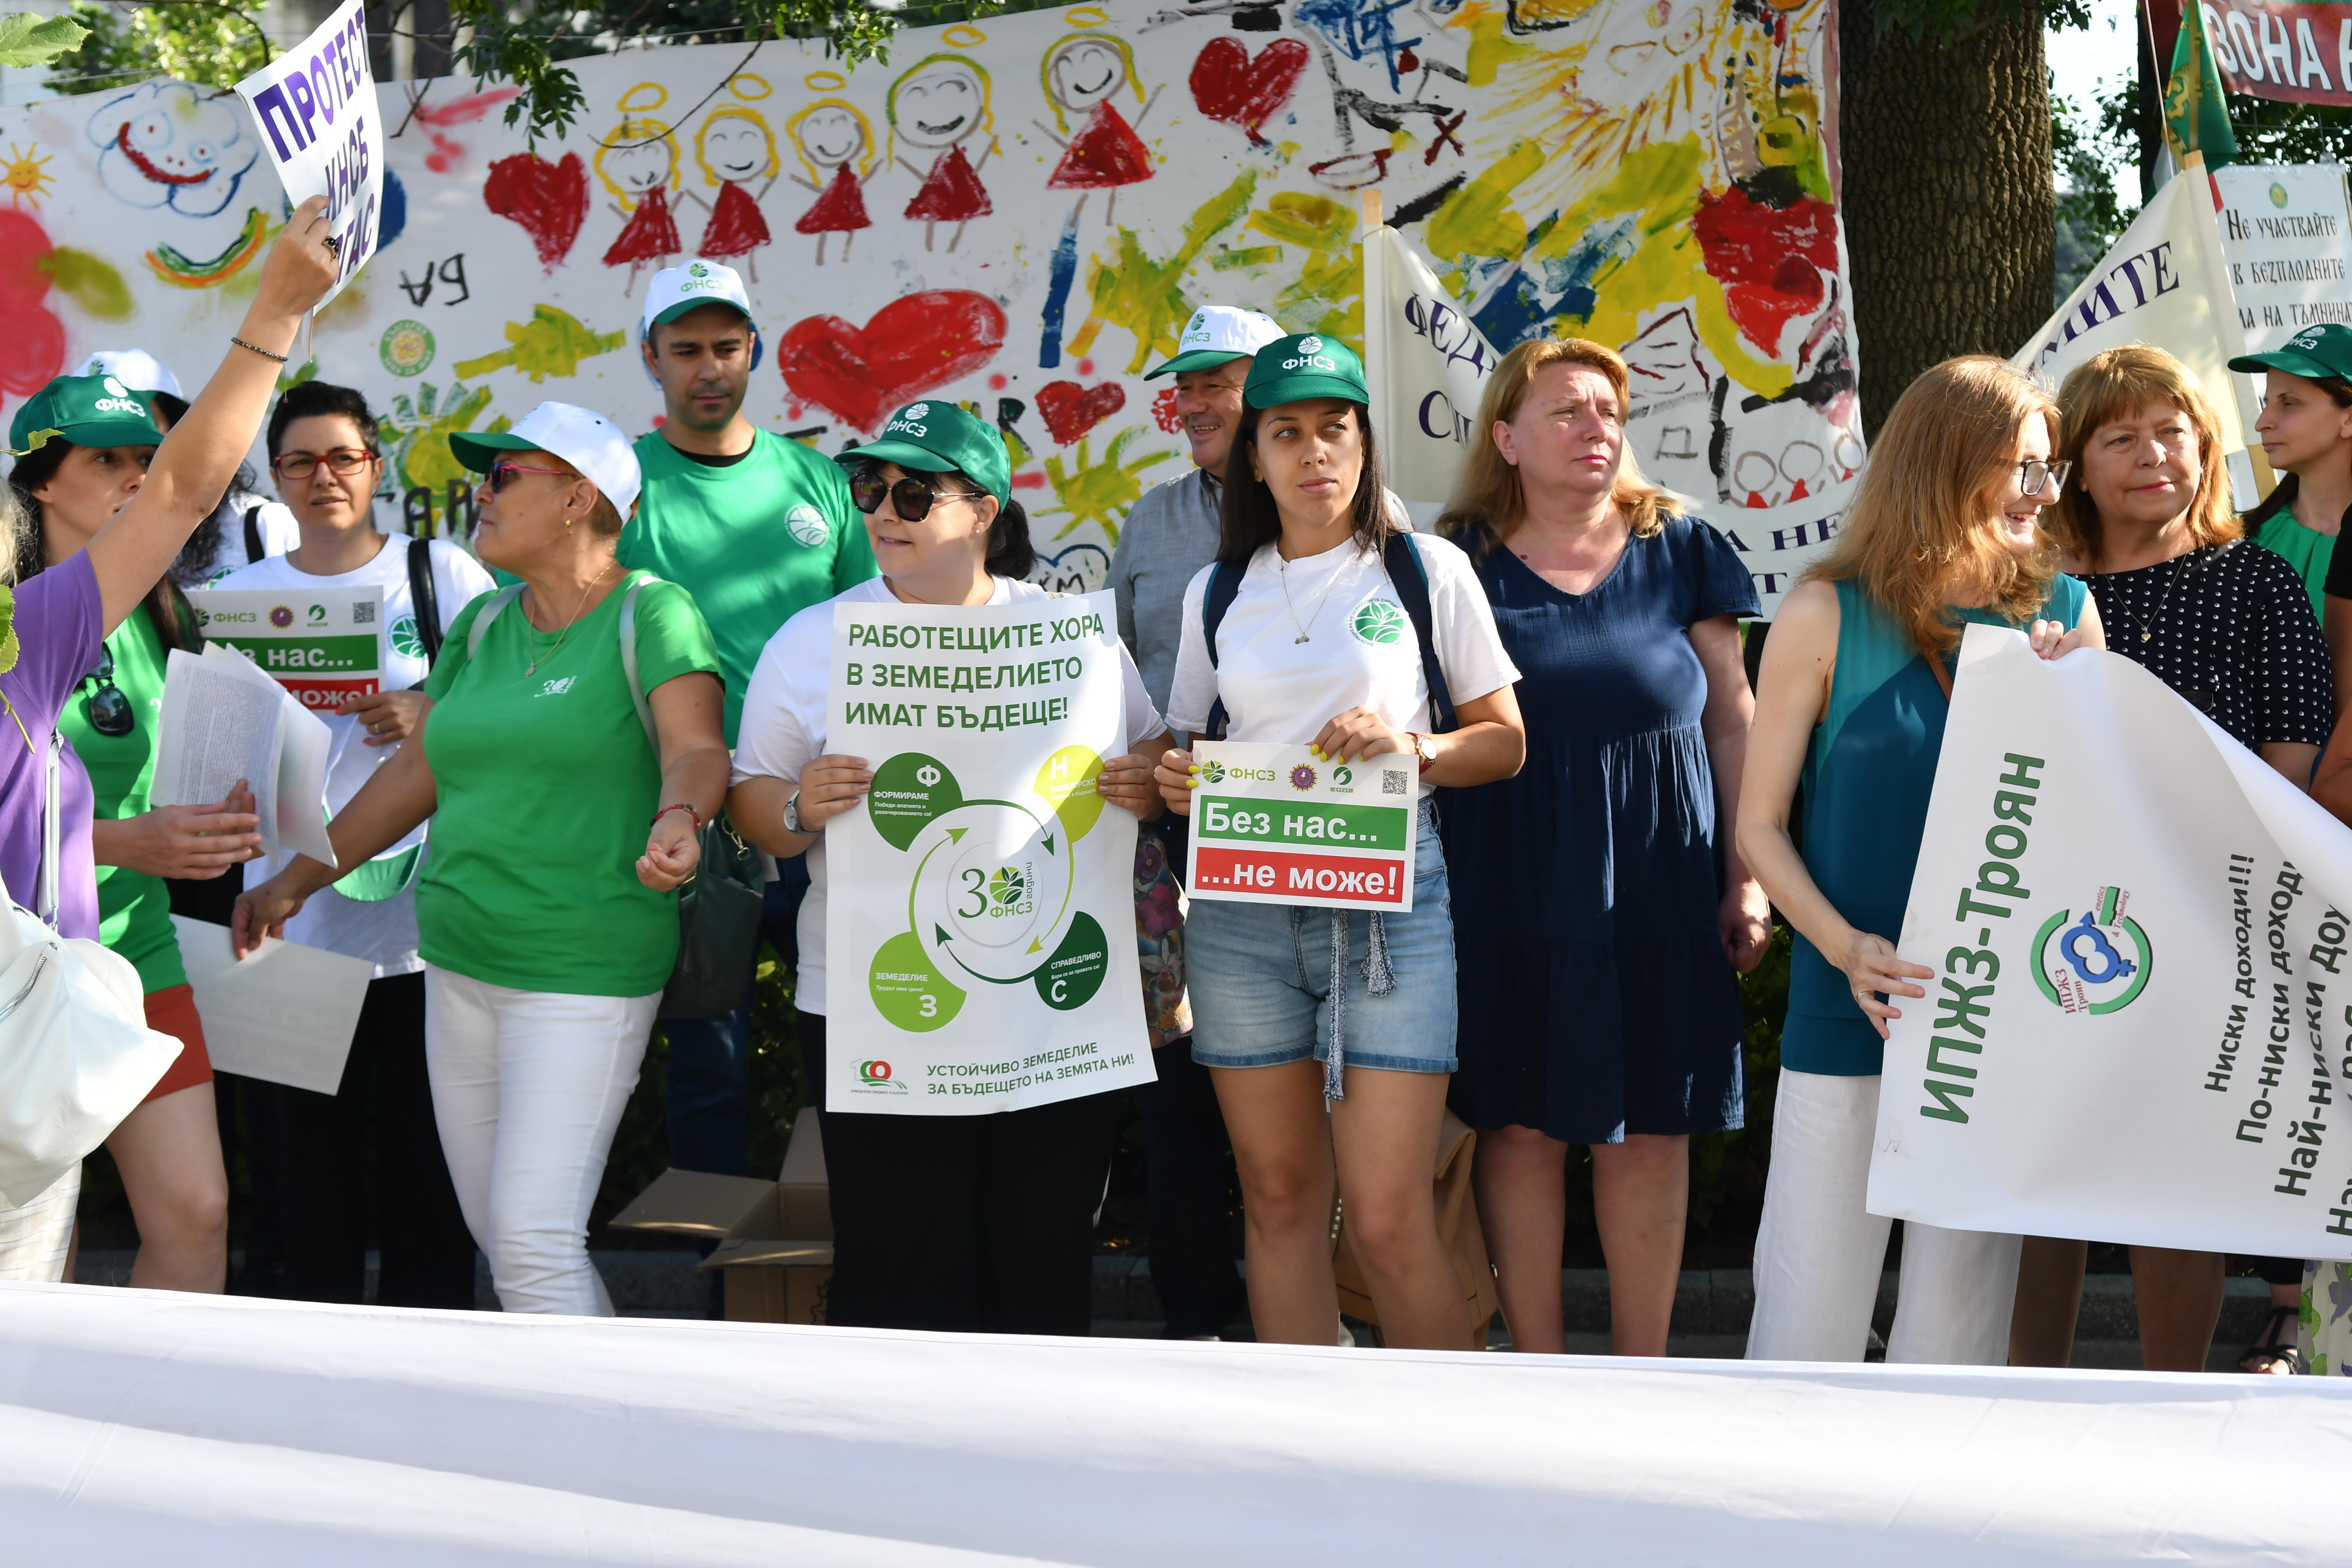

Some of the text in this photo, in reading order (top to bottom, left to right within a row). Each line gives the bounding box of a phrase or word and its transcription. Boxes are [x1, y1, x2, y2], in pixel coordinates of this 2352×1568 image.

[2202, 3, 2332, 91] ЗОНА
[253, 8, 368, 163] ПРОТЕСТ
[325, 115, 368, 222] КНСБ
[2030, 241, 2180, 372] МИТЕ
[1282, 356, 1336, 372] ФНСЗ
[95, 397, 145, 417] ФНСЗ
[214, 613, 256, 622] ФНСЗ
[849, 613, 1105, 654] РАБОТЕЩИТЕ ХОРА
[847, 656, 1082, 693] В ЗЕМЕДЕЛИЕТО
[846, 697, 1069, 732] ИМАТ БЪДЕЩЕ!
[916, 765, 941, 787] Ф
[1051, 755, 1068, 780] Н
[1230, 767, 1276, 782] ФНСЗ
[874, 791, 929, 800] ФОРМИРАМЕ
[1206, 802, 1378, 842] Без нас...
[1201, 863, 1397, 896] ...не може!
[990, 901, 1033, 918] ФНСЗ
[1920, 752, 2045, 1124] ИПЖЗ-Троян
[875, 972, 928, 982] ЗЕМЕДЕЛИЕ
[1051, 951, 1102, 969] СПРАВЕДЛИВО
[1051, 980, 1067, 1002] С
[2055, 969, 2076, 1014] ИПЖЗ
[927, 1042, 1098, 1076] УСТОЙЧИВО ЗЕМЕДЕЛИЕ
[2205, 1003, 2249, 1093] Ниски
[2235, 983, 2290, 1143] По-ниски
[928, 1053, 1135, 1096] ЗА БЪДЕЩЕТО НА ЗЕМЯТА НИ!
[2274, 981, 2332, 1196] Най-ниски
